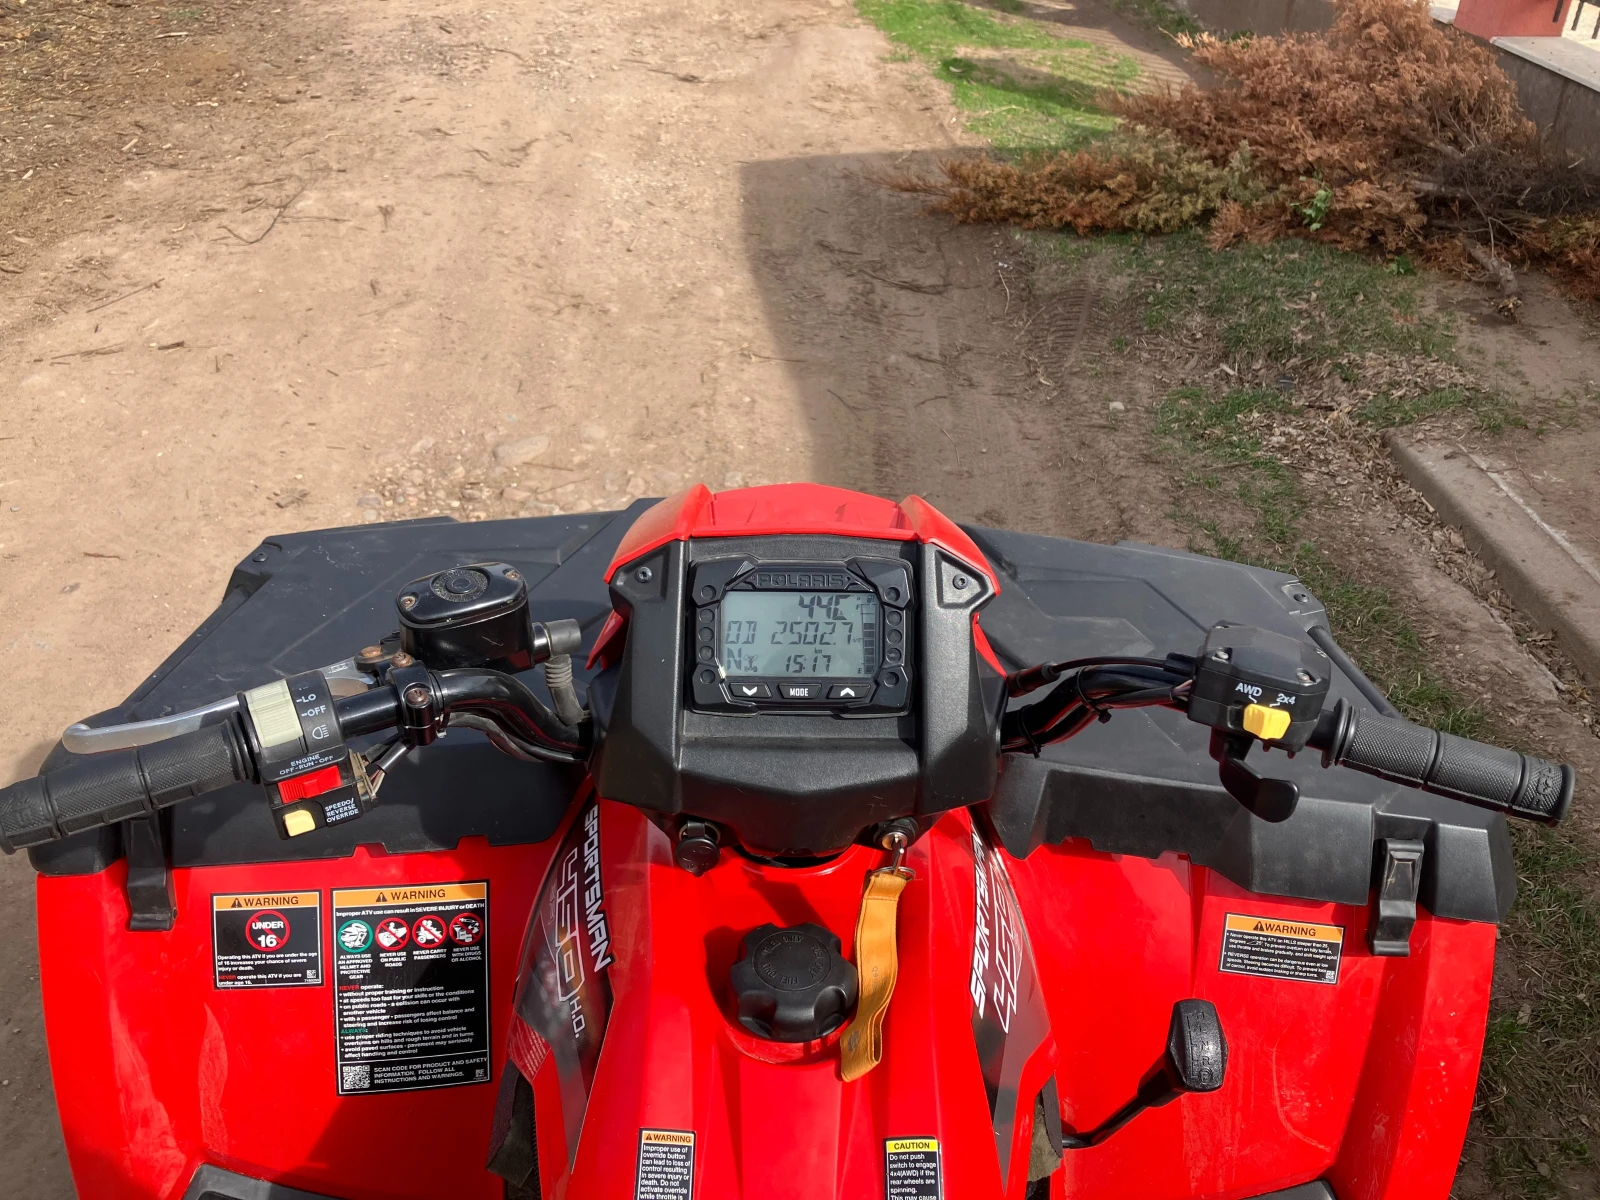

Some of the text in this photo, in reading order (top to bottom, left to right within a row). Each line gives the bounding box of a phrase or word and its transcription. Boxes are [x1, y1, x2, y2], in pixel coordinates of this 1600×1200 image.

[757, 574, 844, 587] POLARIS
[771, 620, 853, 645] 2502.7
[727, 647, 831, 673] N 15:17
[790, 688, 808, 696] MODE
[1235, 683, 1262, 697] AWD
[1277, 694, 1296, 705] 2x4
[291, 754, 320, 767] ENGINE
[326, 804, 356, 817] REVERSE
[327, 809, 359, 823] OVERRIDE
[584, 805, 611, 972] SPORTSMAN
[391, 889, 446, 901] WARNING
[244, 896, 299, 907] WARNING
[252, 921, 284, 929] UNDER
[1265, 923, 1316, 936] WARNING
[258, 935, 277, 947] 16
[782, 934, 803, 943] ONLY
[780, 974, 798, 984] FUEL
[374, 1076, 417, 1084] INSTRUCTIONS
[431, 1071, 464, 1079] WARNINGS.
[653, 1134, 691, 1142] WARNING
[894, 1142, 929, 1150] CAUTION
[910, 1153, 924, 1161] push
